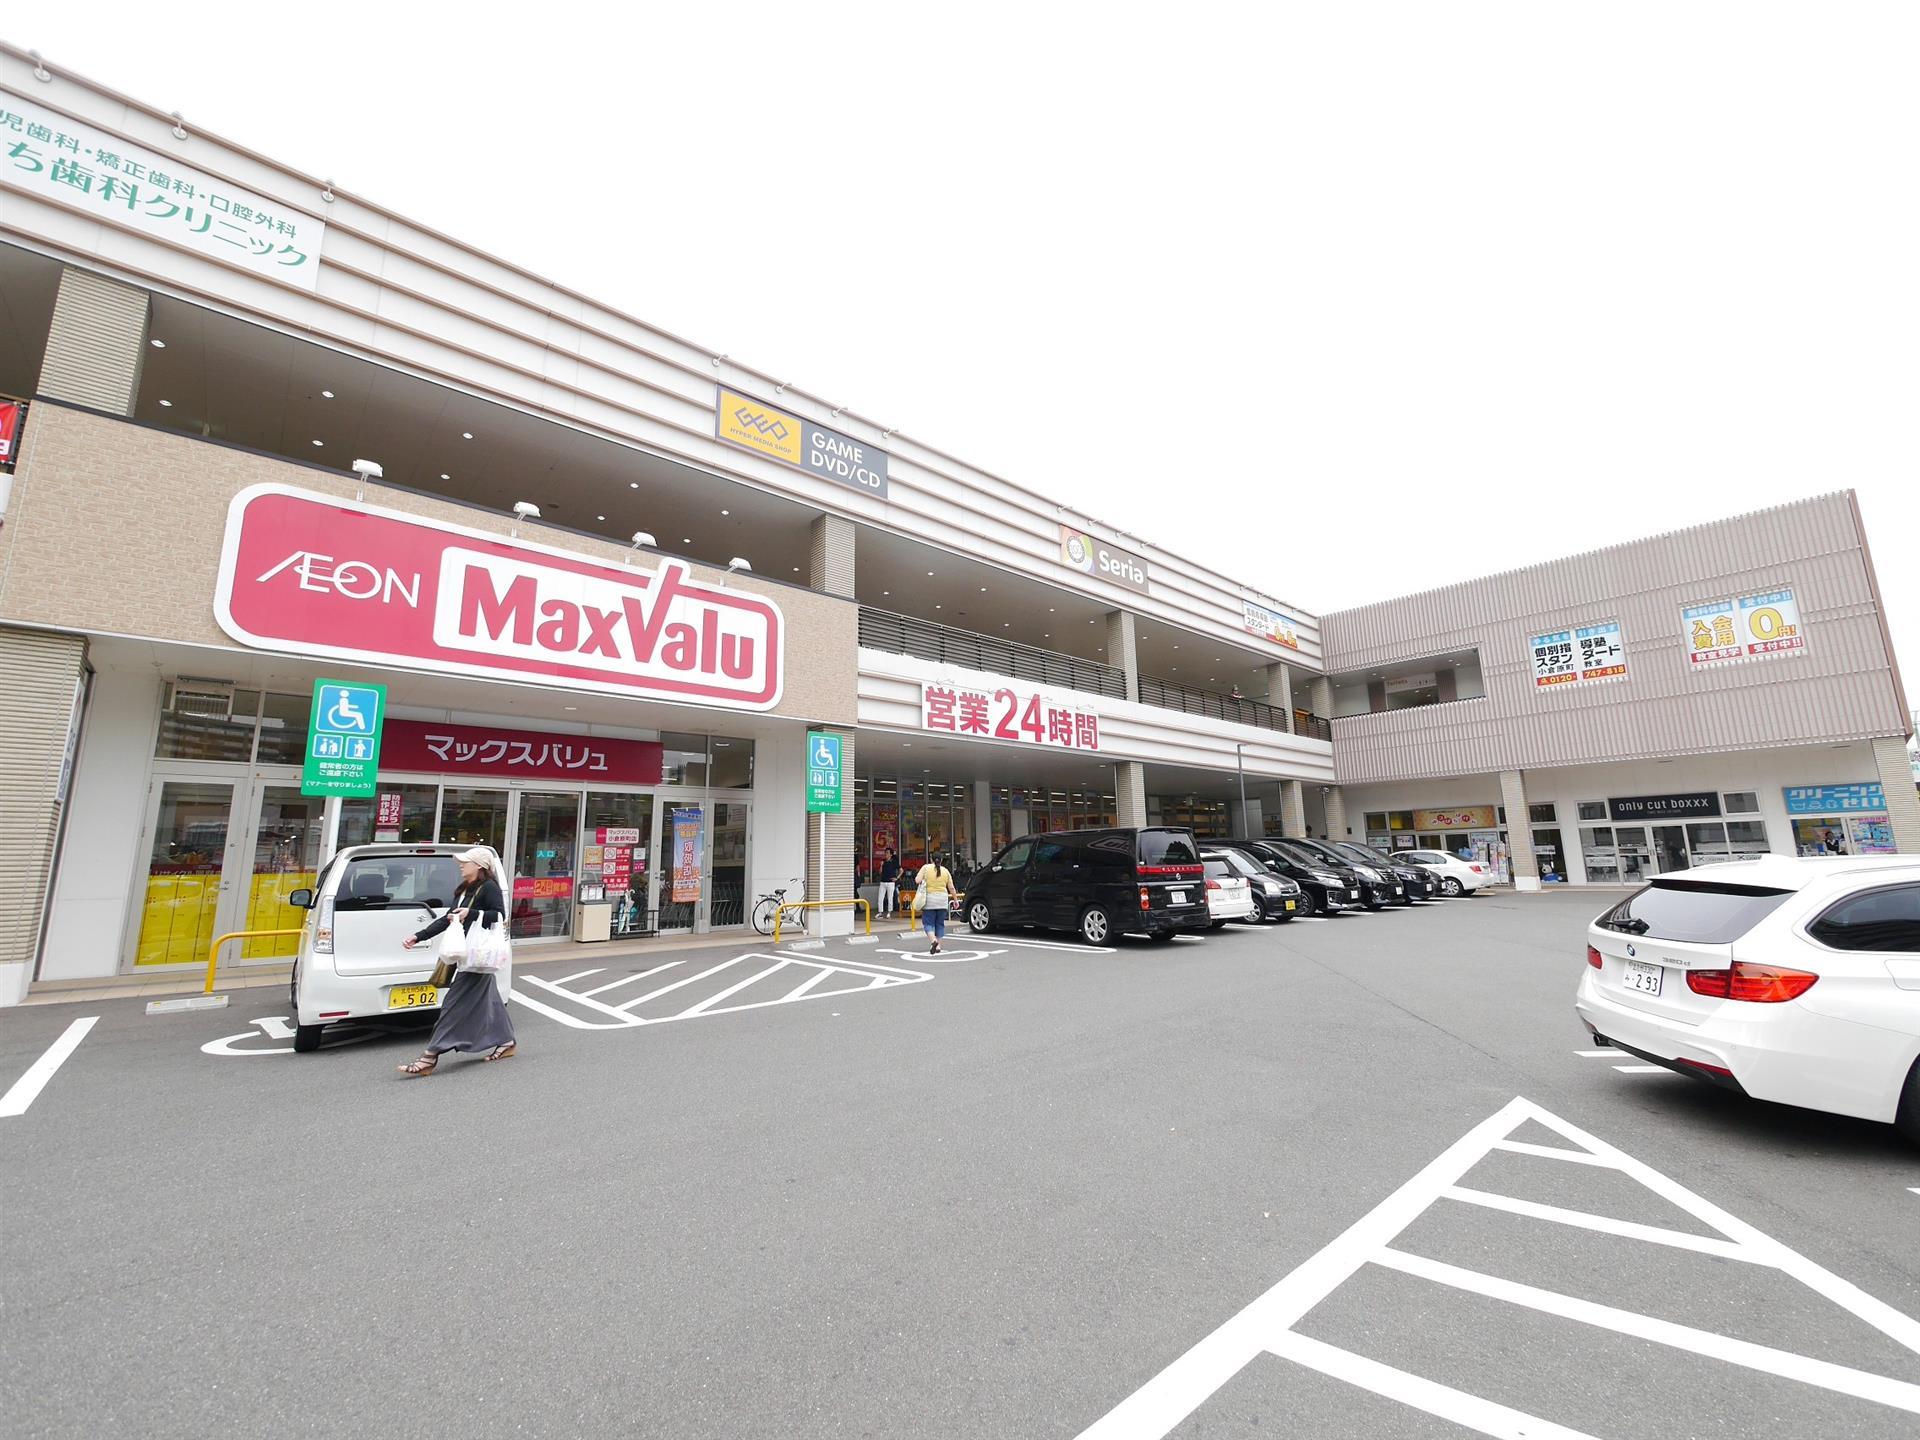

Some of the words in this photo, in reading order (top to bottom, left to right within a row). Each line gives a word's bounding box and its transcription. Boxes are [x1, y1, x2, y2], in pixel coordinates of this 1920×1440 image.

[752, 435, 774, 449] MEDIA
[811, 431, 863, 464] GAME
[811, 448, 881, 488] DVD/CD
[1098, 550, 1144, 585] Seria
[457, 564, 755, 680] MaxValu
[925, 687, 1099, 750] 営業24時間
[425, 734, 608, 771] マックスバリュ
[1619, 801, 1643, 813] only
[1647, 798, 1667, 810] cut
[1671, 794, 1709, 808] boxxx
[537, 850, 555, 858] 入口
